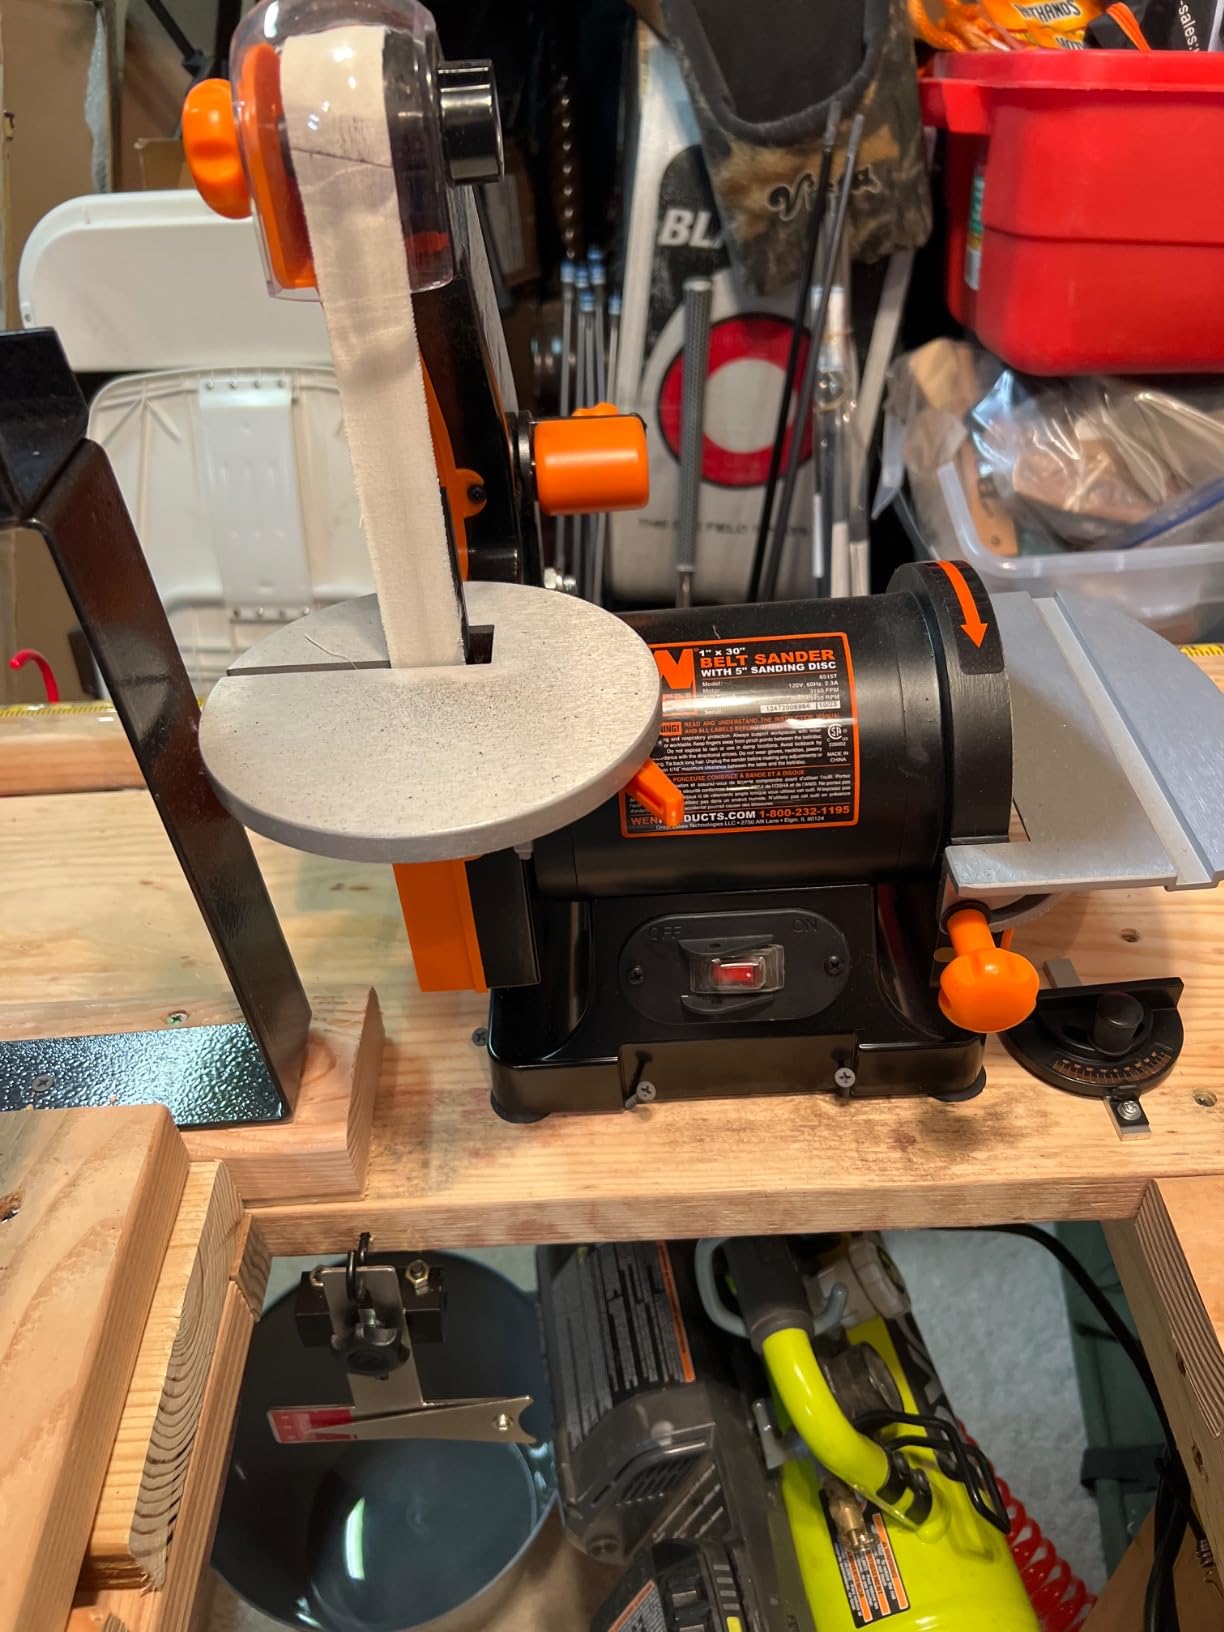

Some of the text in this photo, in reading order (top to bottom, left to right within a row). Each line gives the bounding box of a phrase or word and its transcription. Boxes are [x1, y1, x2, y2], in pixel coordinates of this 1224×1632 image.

[658, 207, 720, 248] BL
[700, 649, 836, 668] BELT SANDER
[701, 668, 732, 677] WITH
[751, 664, 806, 673] SANDING
[808, 661, 837, 670] DISC
[631, 806, 850, 825] WENDUCTS.COM 1-800-232-1195
[792, 918, 818, 933] ON
